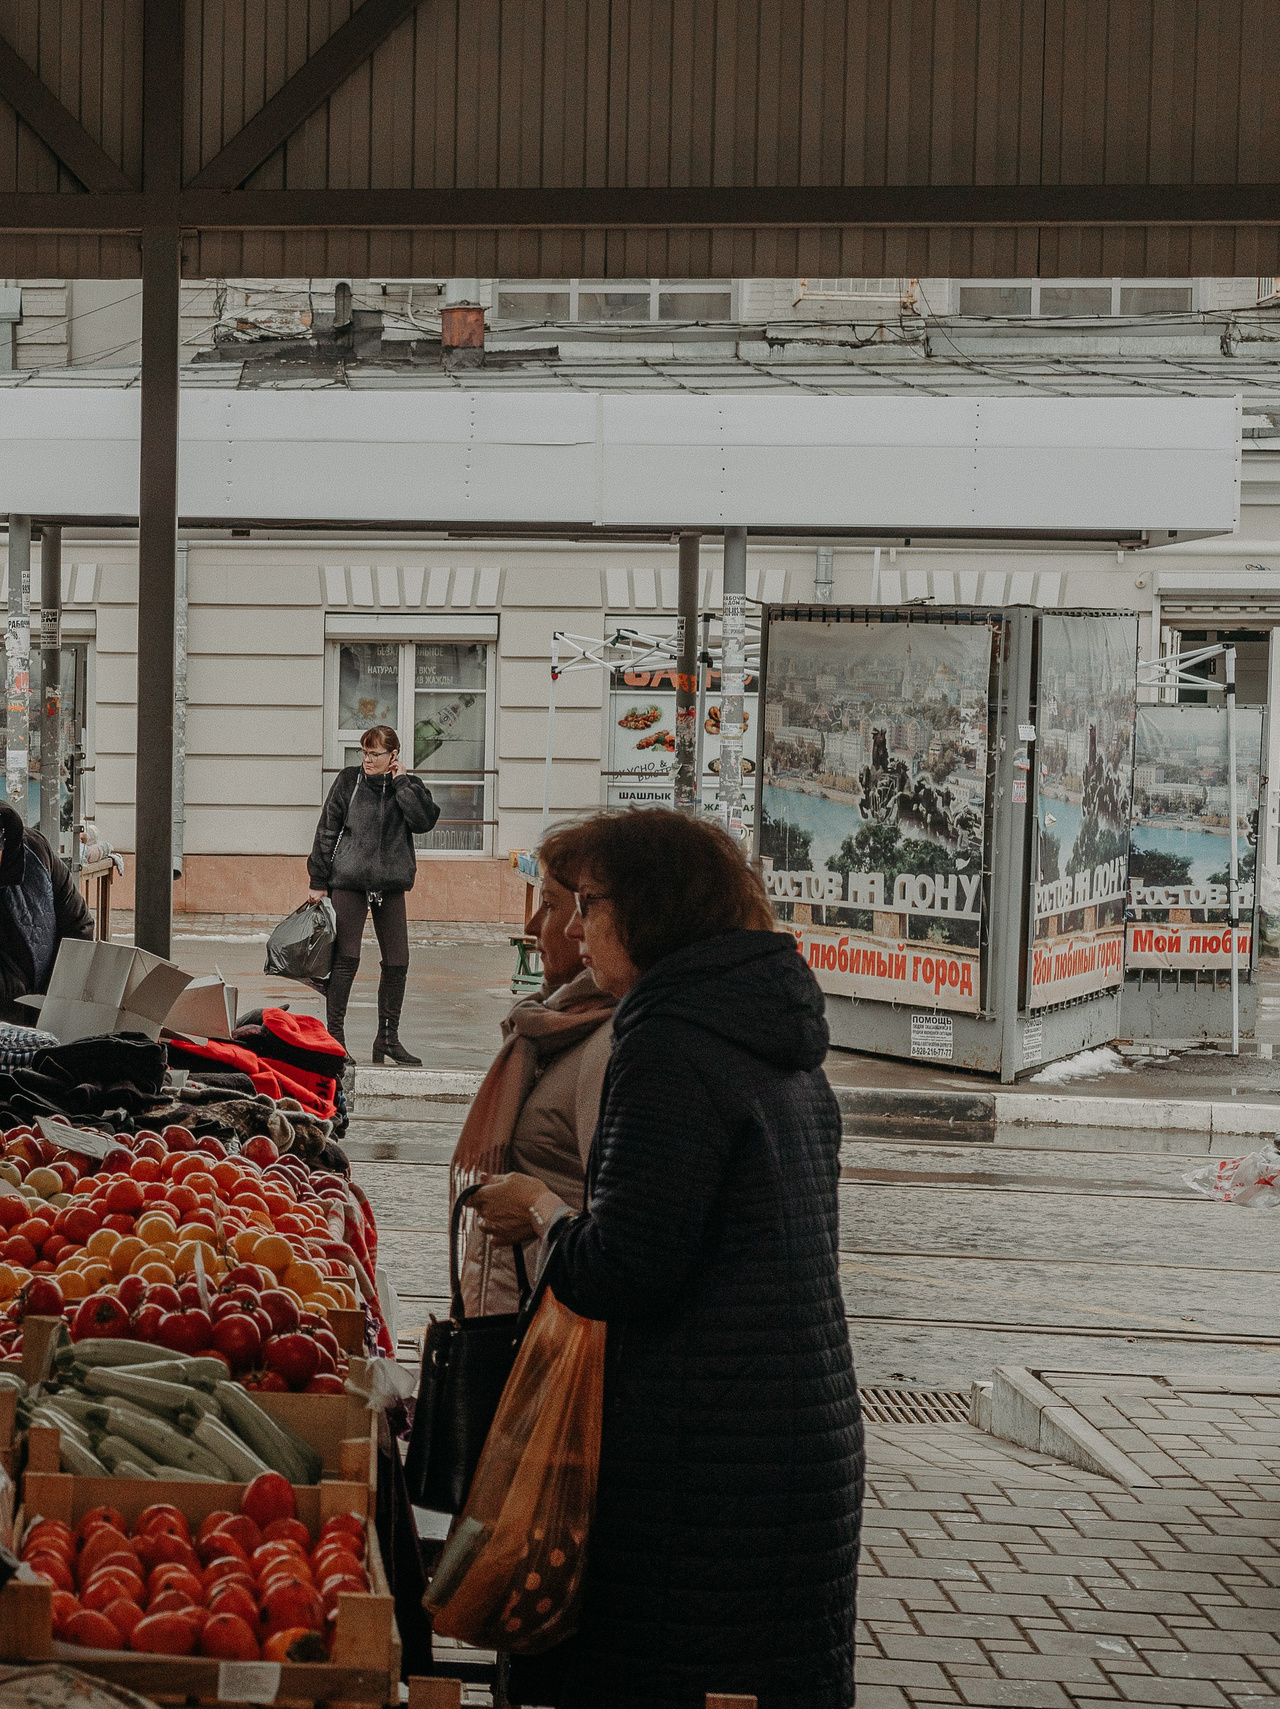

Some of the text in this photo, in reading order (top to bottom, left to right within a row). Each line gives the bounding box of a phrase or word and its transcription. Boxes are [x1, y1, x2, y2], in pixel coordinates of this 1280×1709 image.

[619, 792, 671, 800] ШАШЛЫК
[893, 873, 981, 914] ДОНУ
[1128, 882, 1228, 906] РОСТОВ
[1133, 929, 1181, 953] Мой
[808, 936, 907, 980] любимый
[913, 956, 973, 996] город
[1033, 945, 1053, 985] Мой
[1054, 936, 1095, 980] любимый
[912, 1016, 952, 1026] ПОМОЩЬ
